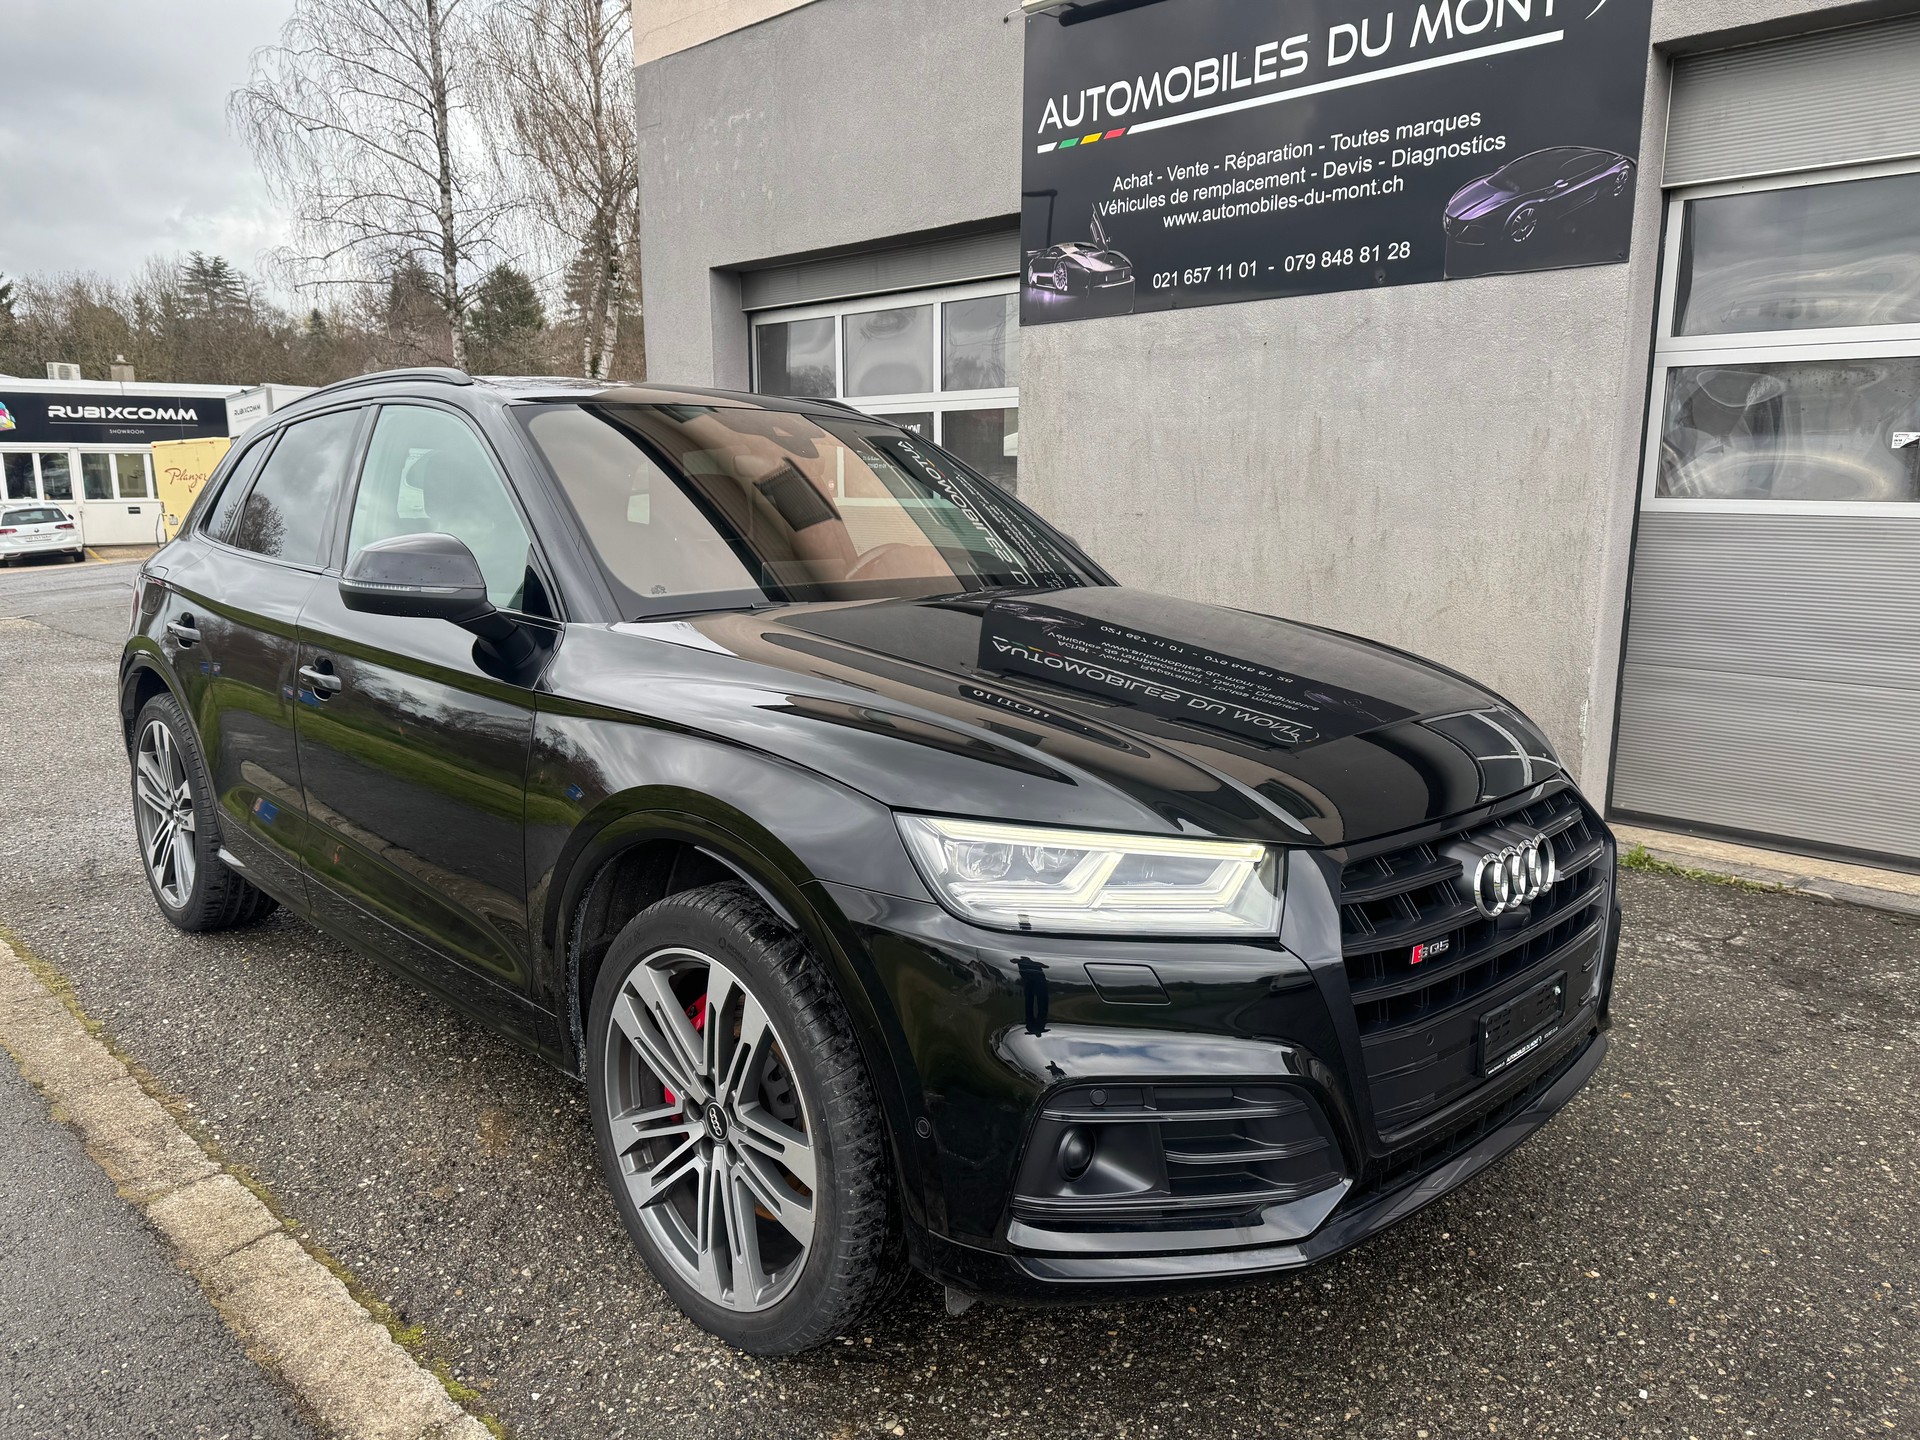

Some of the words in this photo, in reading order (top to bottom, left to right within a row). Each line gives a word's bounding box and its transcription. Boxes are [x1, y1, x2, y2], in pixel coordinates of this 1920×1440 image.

[1037, 33, 1309, 134] AUTOMOBILES
[1327, 12, 1394, 67] DU
[1098, 193, 1166, 217] Véhicules
[1170, 187, 1189, 205] de
[1193, 167, 1306, 201] remplacement
[1322, 156, 1373, 179] Devis
[1391, 134, 1507, 168] Diagnostics
[1112, 171, 1154, 192] Achat
[1166, 161, 1210, 182] Vente
[1224, 142, 1314, 172] Réparation
[1330, 127, 1390, 152] Toutes
[1395, 111, 1482, 140] marques
[1162, 175, 1404, 228] www.automobiles-du-mont.ch
[1152, 270, 1178, 289] 021
[1183, 266, 1212, 285] 657
[1217, 263, 1233, 281] 11
[1238, 260, 1258, 278] 01
[1284, 252, 1317, 273] 079
[1320, 248, 1354, 268] 848
[1359, 244, 1381, 263] 81
[1387, 241, 1412, 260] 28
[47, 405, 199, 421] RUBIXCOMM
[164, 467, 208, 493] Planzer
[1417, 939, 1450, 959] SQ5
